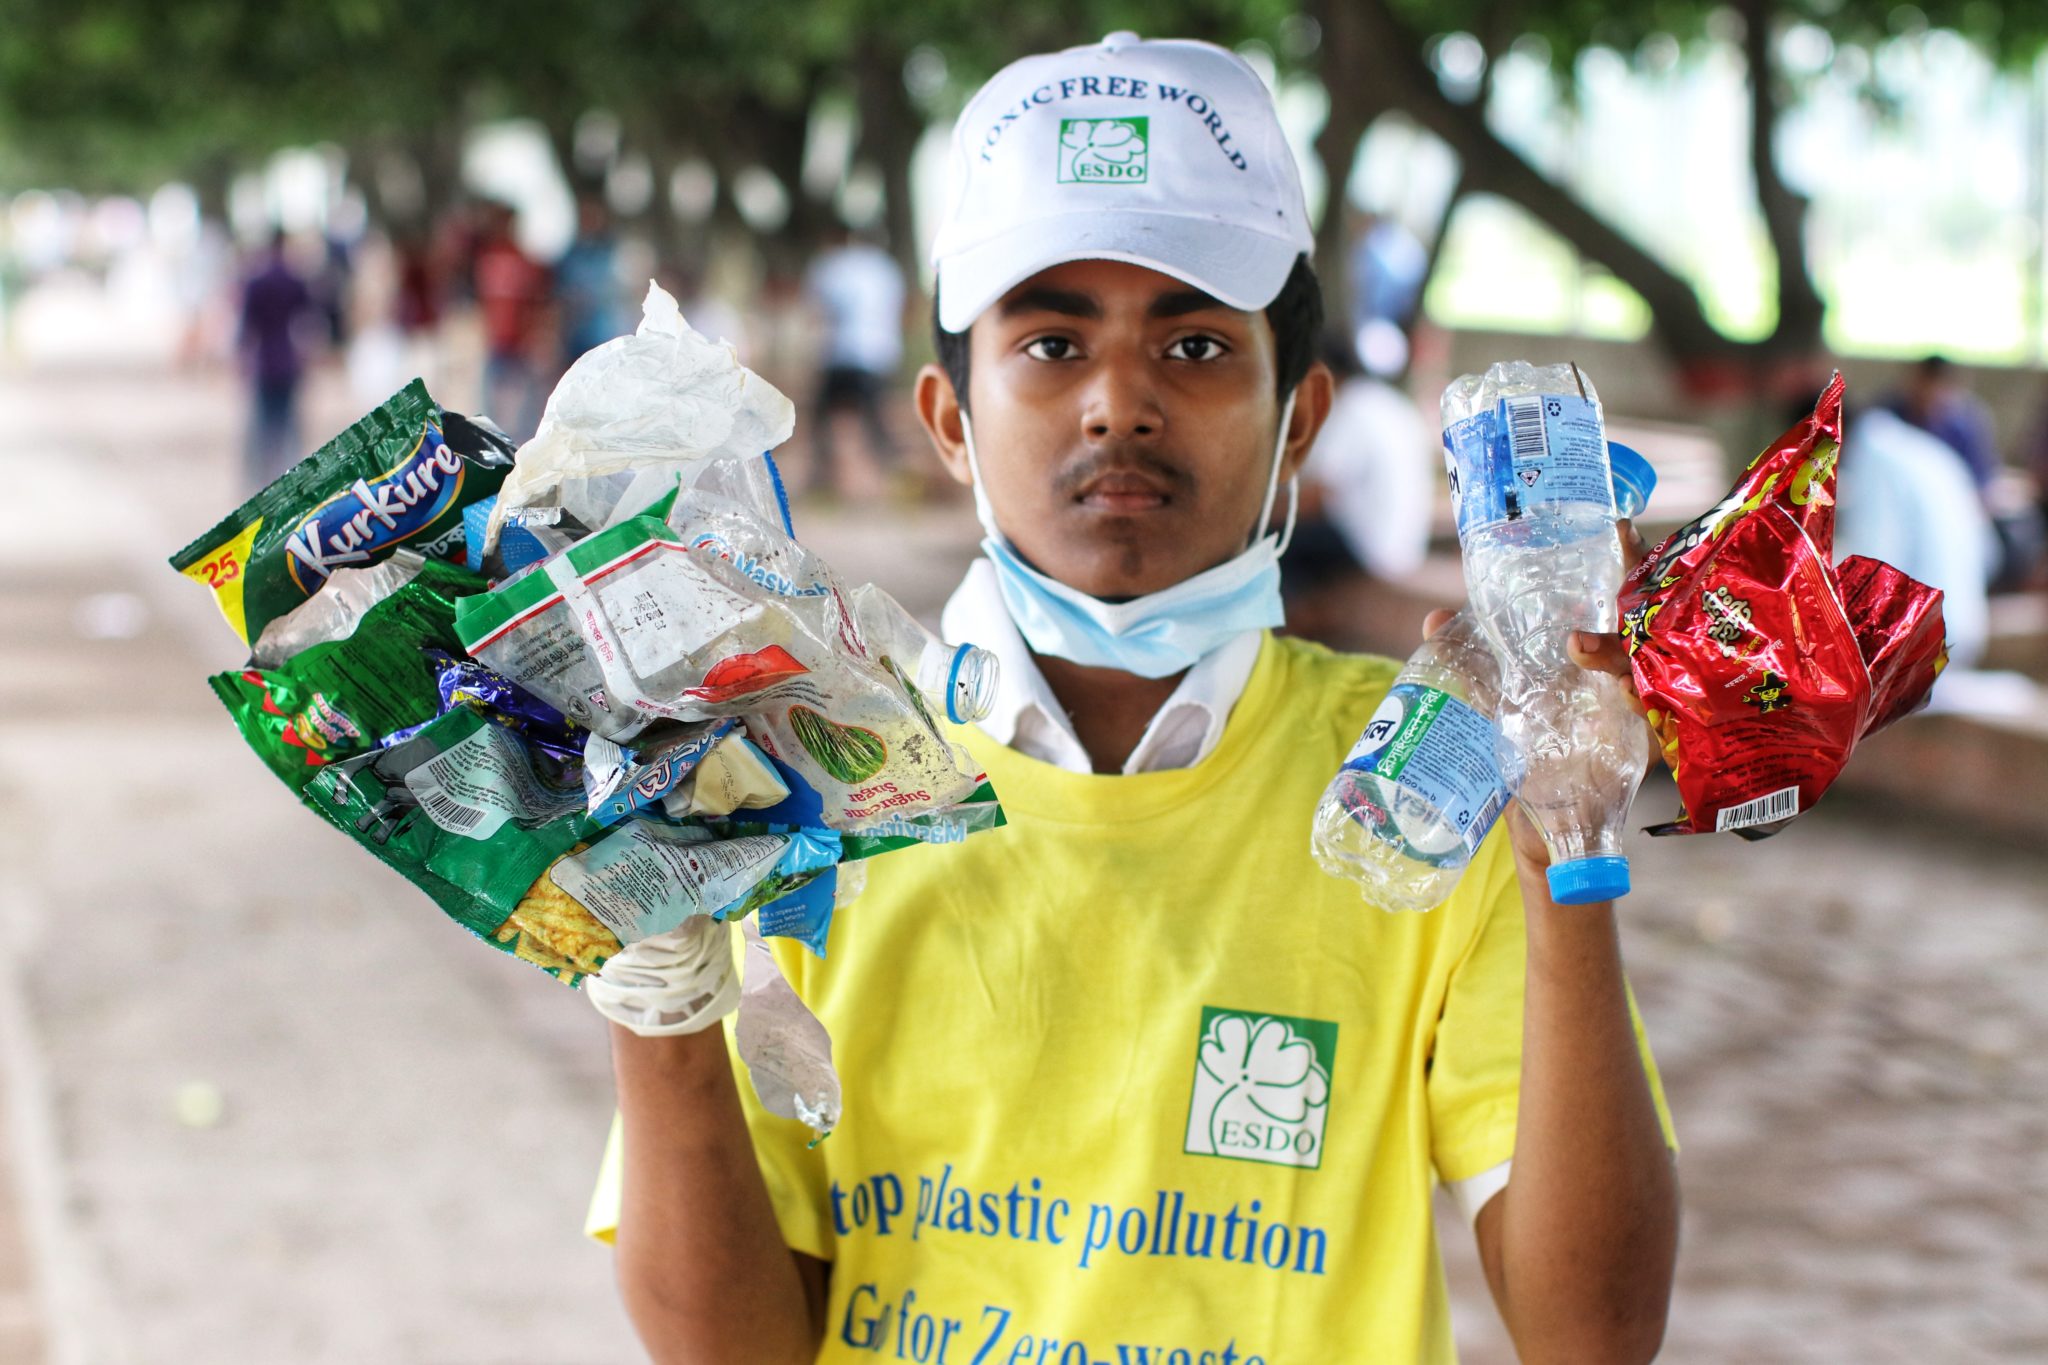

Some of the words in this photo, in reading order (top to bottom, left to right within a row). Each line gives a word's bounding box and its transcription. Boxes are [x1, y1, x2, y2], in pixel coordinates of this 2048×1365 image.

[980, 85, 1053, 164] TOXIC
[1060, 76, 1149, 99] FREE
[1157, 84, 1248, 172] WORLD
[1079, 163, 1144, 179] ESDO
[284, 443, 462, 580] Kurkure
[202, 551, 239, 590] 25
[843, 790, 931, 819] Sugarcane
[848, 782, 898, 803] Sugar
[1219, 1120, 1316, 1157] ESDO
[829, 1171, 903, 1236] top
[913, 1164, 1069, 1245] plastic
[1078, 1190, 1327, 1275] pollution
[897, 1289, 961, 1365] for
